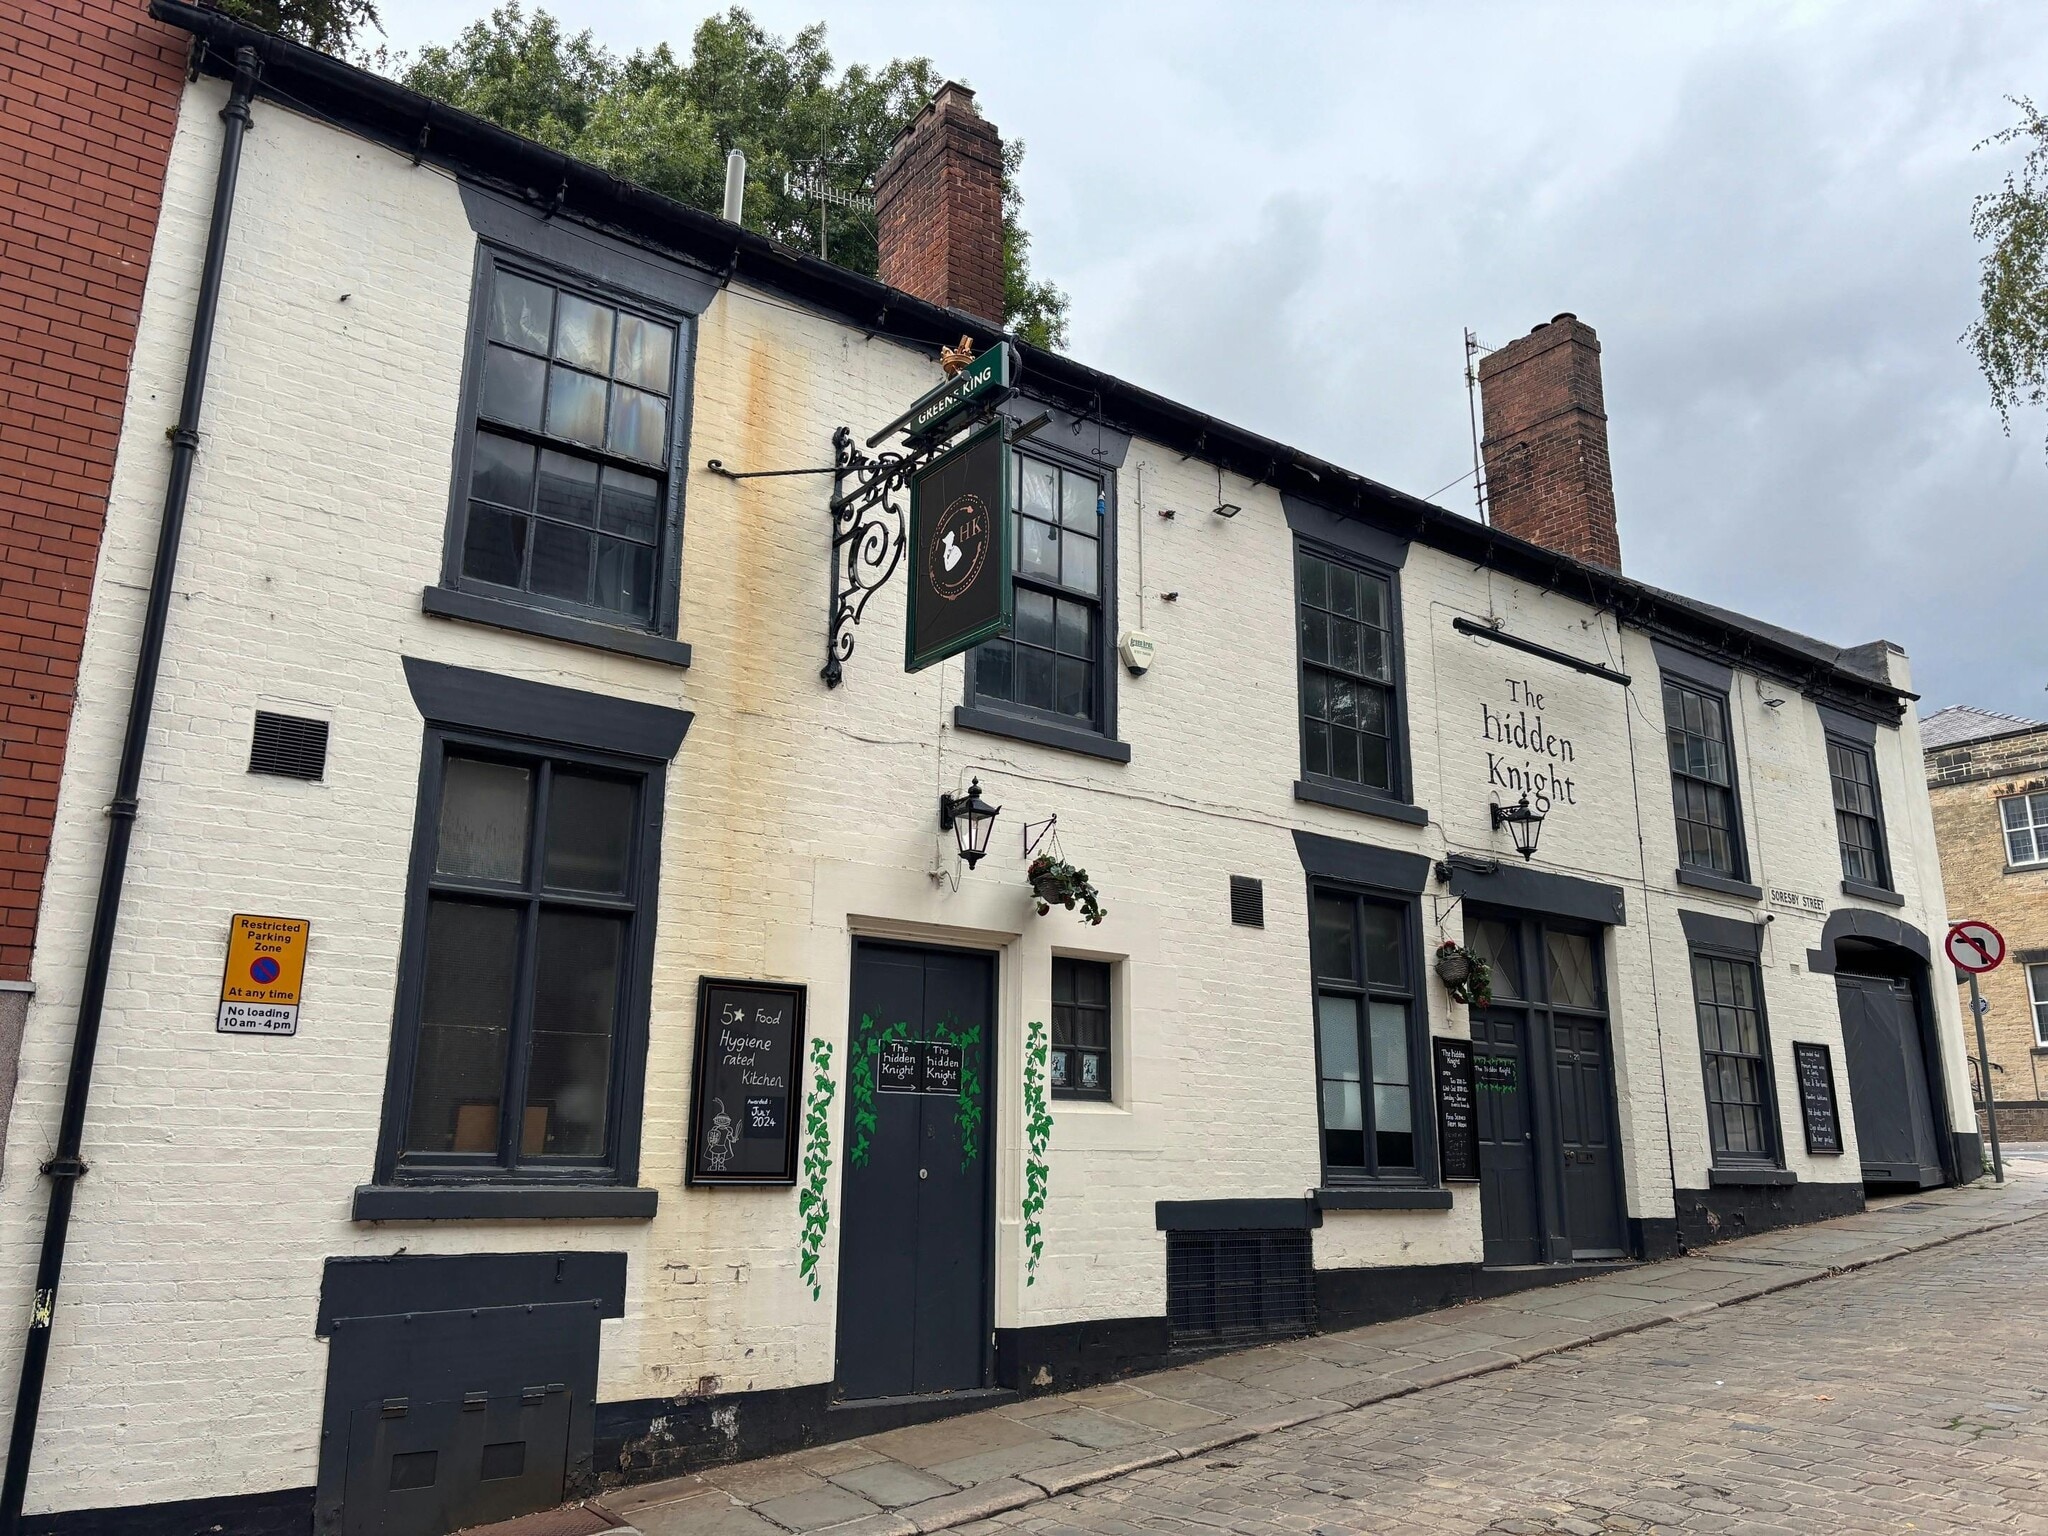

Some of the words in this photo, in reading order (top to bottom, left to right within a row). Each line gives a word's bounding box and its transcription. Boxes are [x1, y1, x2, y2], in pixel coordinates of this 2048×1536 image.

[962, 367, 991, 396] KING
[960, 515, 982, 543] HK
[1505, 678, 1545, 711] The
[1480, 702, 1575, 762] hidden
[1486, 752, 1577, 812] Knight
[1771, 890, 1800, 906] SORESBY
[1802, 896, 1824, 910] STREET
[242, 920, 300, 932] Restricted
[248, 931, 292, 944] Parking
[254, 942, 282, 952] Zone
[228, 987, 242, 996] At
[246, 990, 265, 999] any
[270, 990, 294, 999] time
[228, 1006, 244, 1016] No
[248, 1008, 290, 1020] loading
[755, 1008, 782, 1025] Food
[720, 1028, 772, 1052] Hygiene
[891, 1043, 908, 1053] The
[933, 1046, 948, 1056] The
[1441, 1048, 1451, 1057] The
[723, 1053, 756, 1066] rated
[883, 1052, 916, 1064] hidden
[926, 1056, 958, 1068] hidden
[742, 1068, 784, 1088] Kitchen
[882, 1063, 914, 1080] Knight
[926, 1068, 956, 1086] Knight
[752, 1116, 776, 1127] 2024
